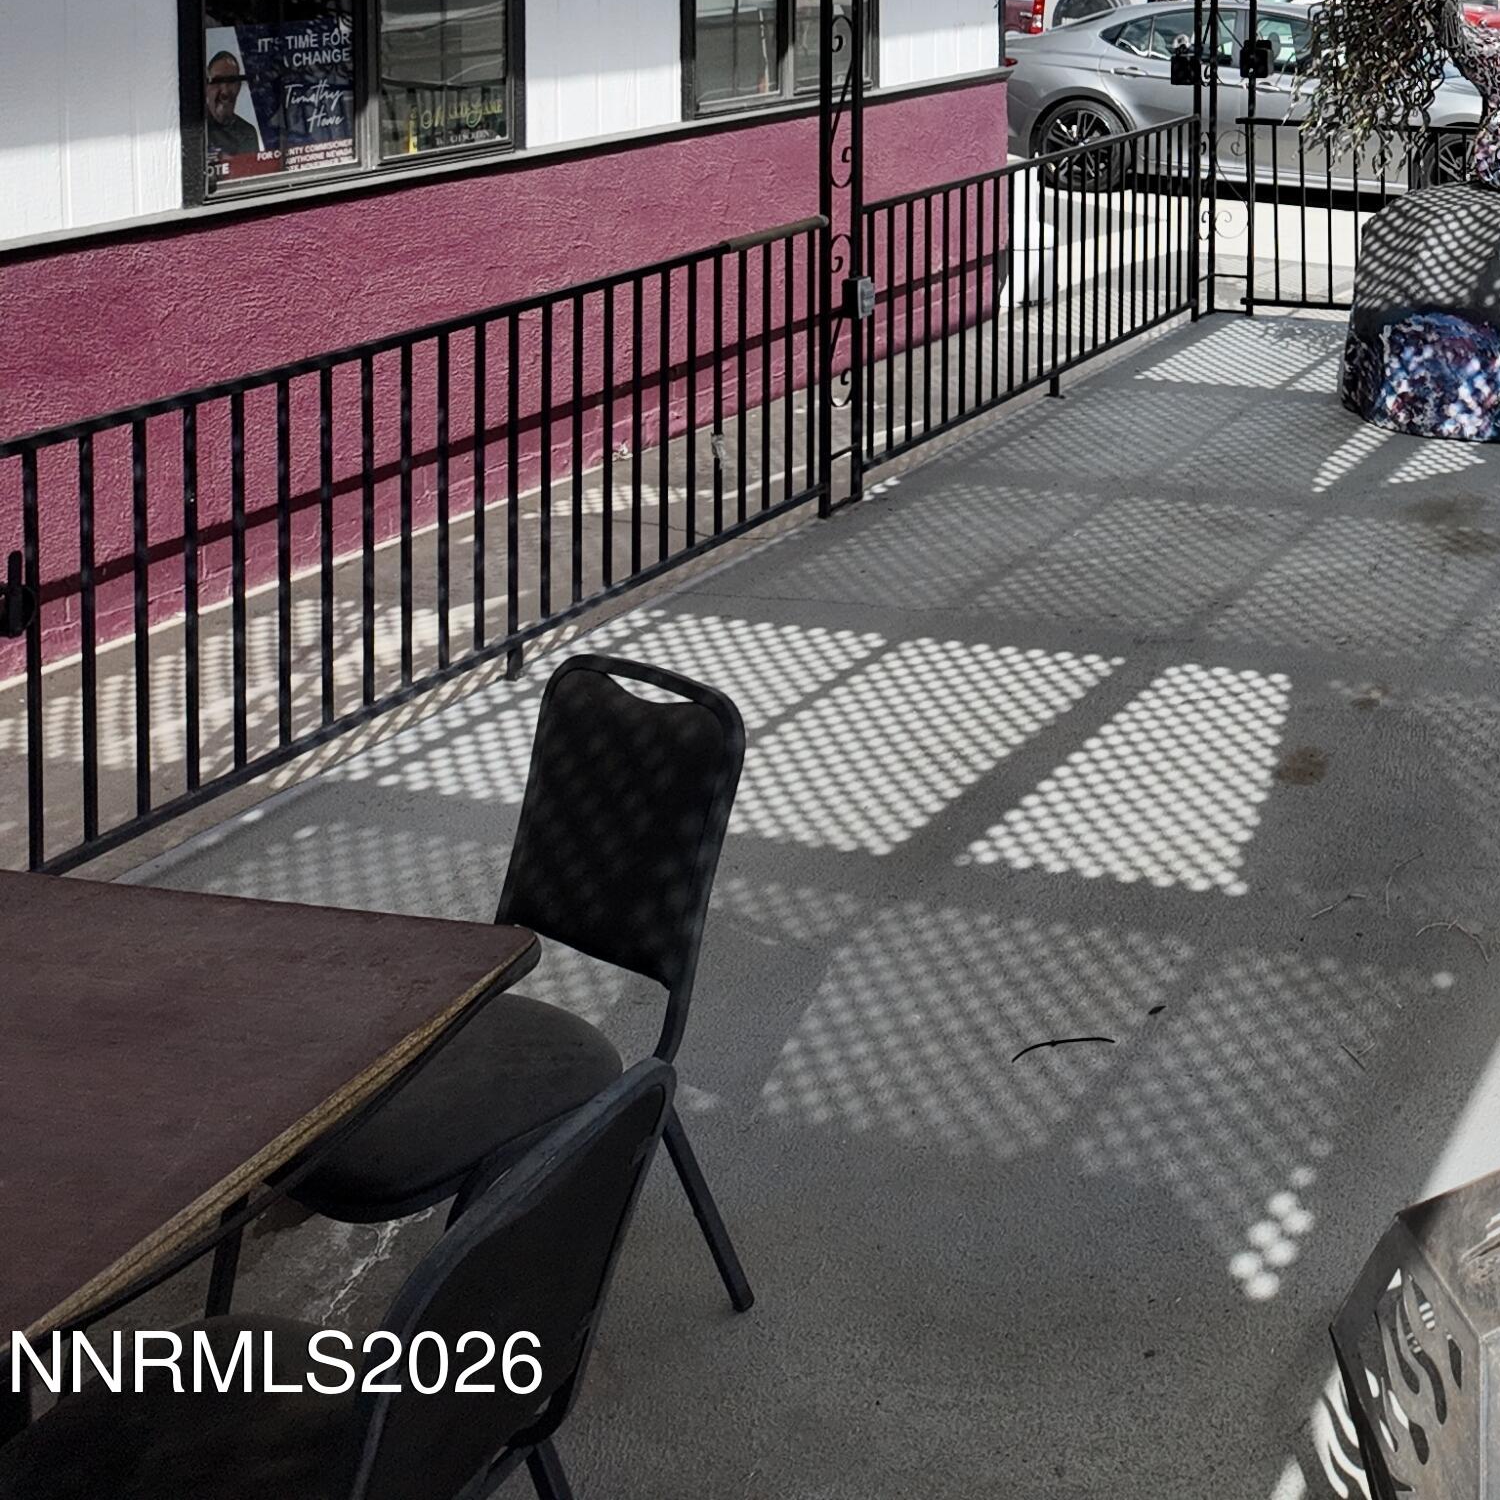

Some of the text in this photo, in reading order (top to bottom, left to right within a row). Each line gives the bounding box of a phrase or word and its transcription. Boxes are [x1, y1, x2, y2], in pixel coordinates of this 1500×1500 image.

[285, 32, 319, 50] TIME
[322, 30, 351, 46] FOR
[292, 48, 351, 67] CHANGE
[257, 151, 273, 161] FOR
[204, 163, 230, 177] OTE
